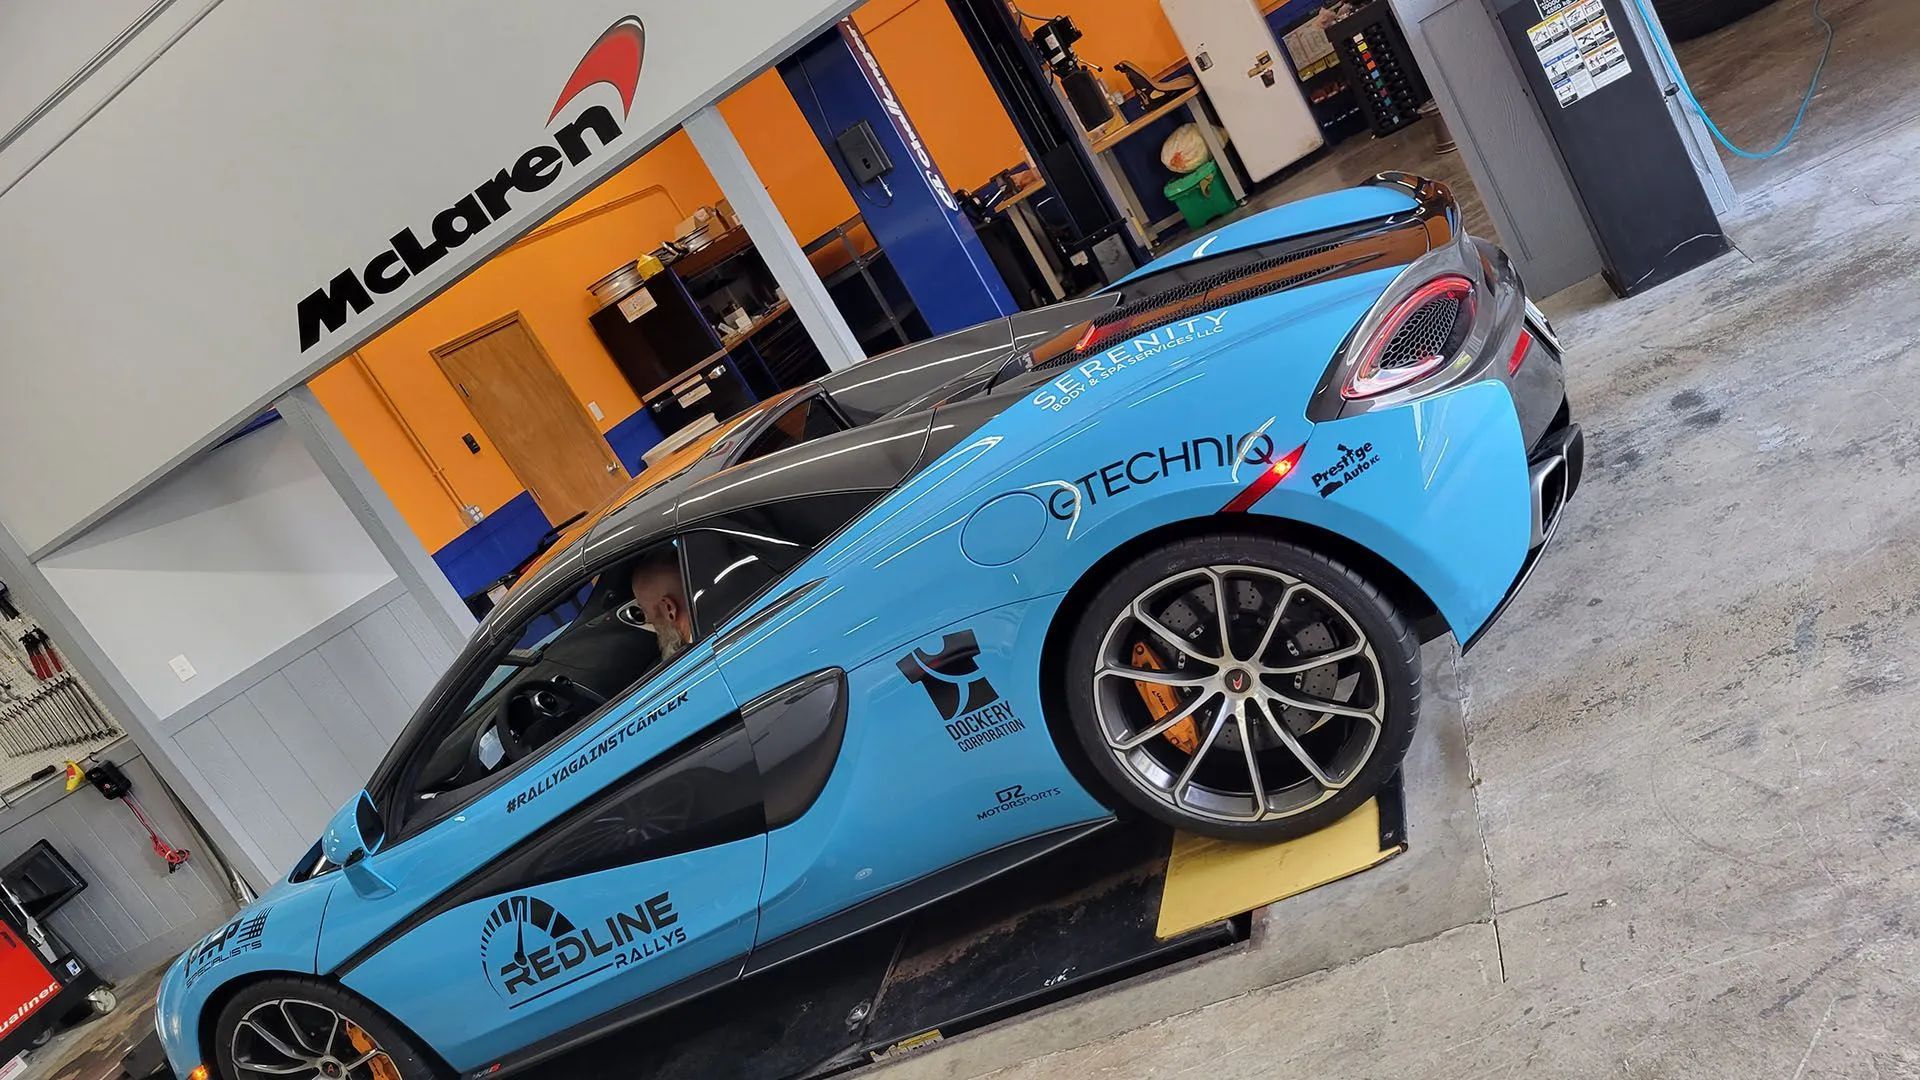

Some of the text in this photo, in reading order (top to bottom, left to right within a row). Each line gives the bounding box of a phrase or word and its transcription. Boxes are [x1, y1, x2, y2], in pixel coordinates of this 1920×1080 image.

[296, 105, 623, 353] McLaren
[1032, 310, 1228, 410] SERENITY
[1051, 325, 1225, 412] BODY & SPA SERVICES LLC
[1048, 431, 1275, 521] GTECHNIQ
[1311, 442, 1373, 488] Prestige
[1343, 454, 1380, 484] Auto KC
[945, 700, 1015, 741] DOCKERY
[957, 718, 1026, 752] CORPORATION
[505, 690, 689, 814] #RALLYAGAINSTCANCER
[976, 787, 1062, 820] MOTORSPORTS
[186, 940, 262, 989] SPECIALISTS
[500, 891, 679, 995] REDLINE
[614, 926, 687, 969] RALLYS
